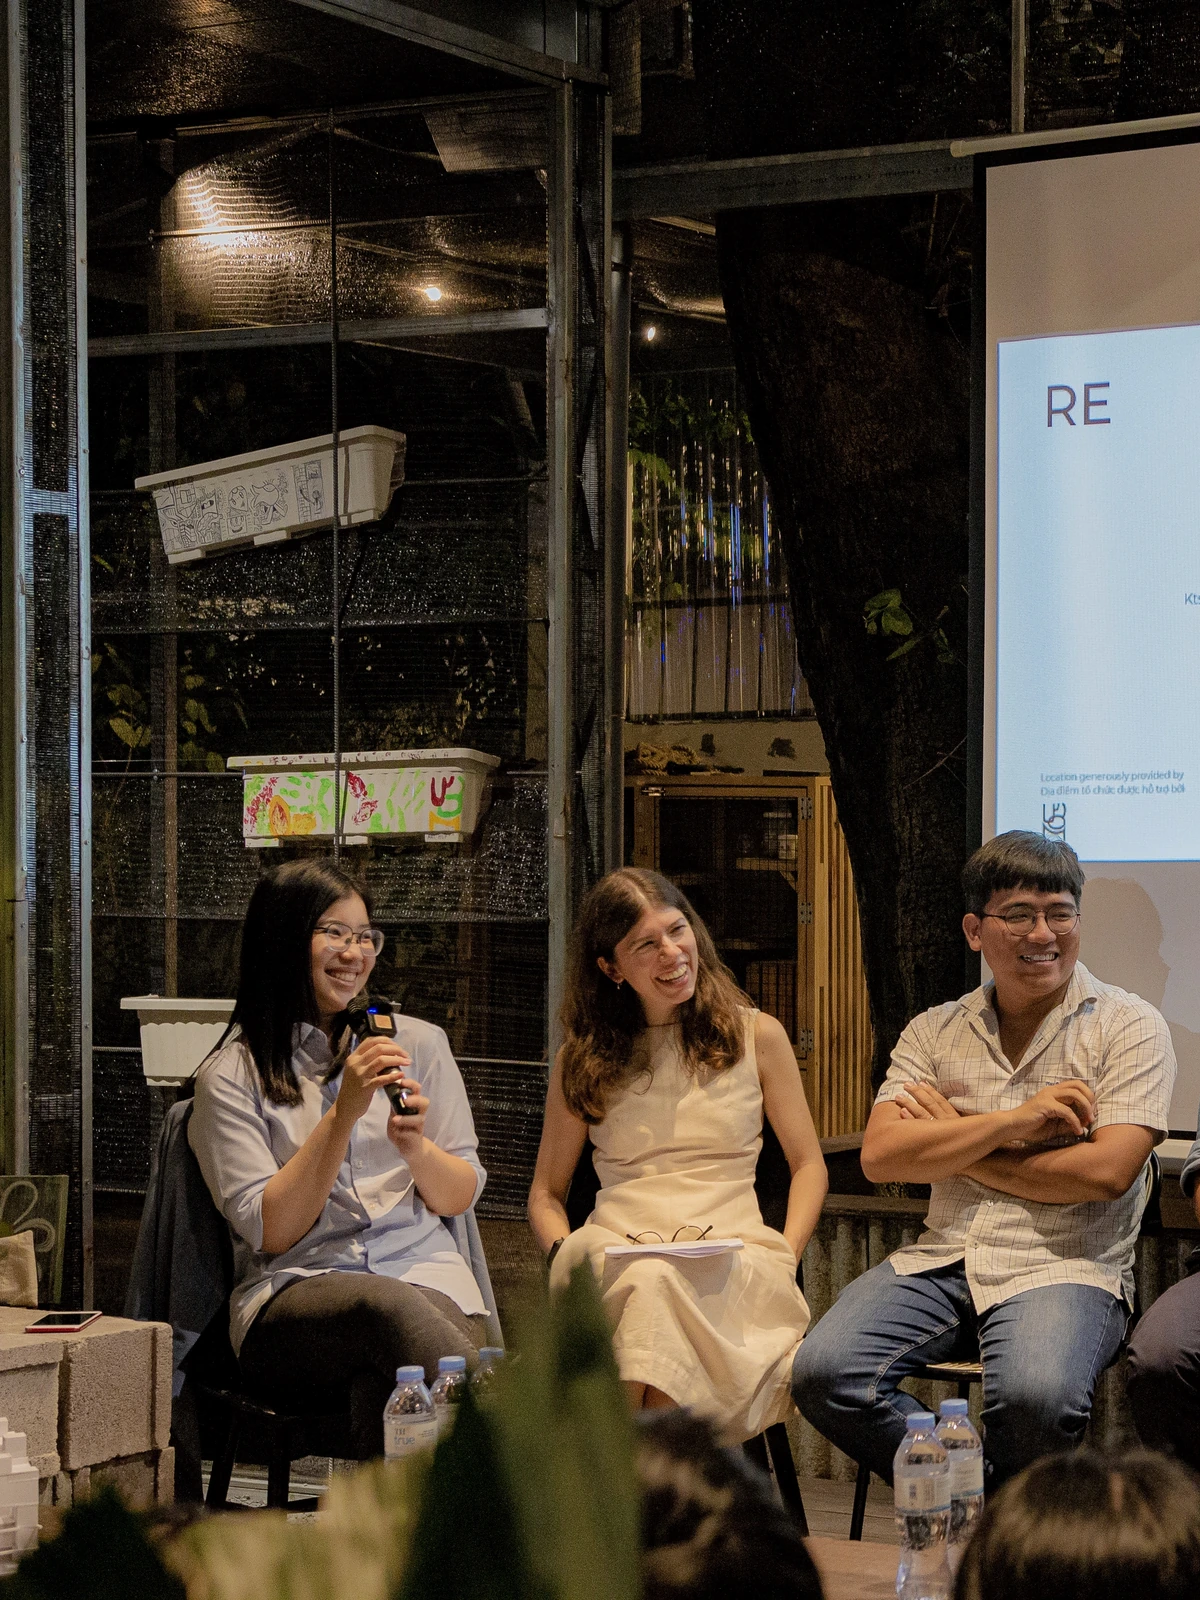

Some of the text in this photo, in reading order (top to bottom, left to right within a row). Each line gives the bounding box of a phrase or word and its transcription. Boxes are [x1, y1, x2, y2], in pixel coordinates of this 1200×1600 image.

[1047, 381, 1111, 427] RE
[1040, 770, 1184, 783] Location generously provided by
